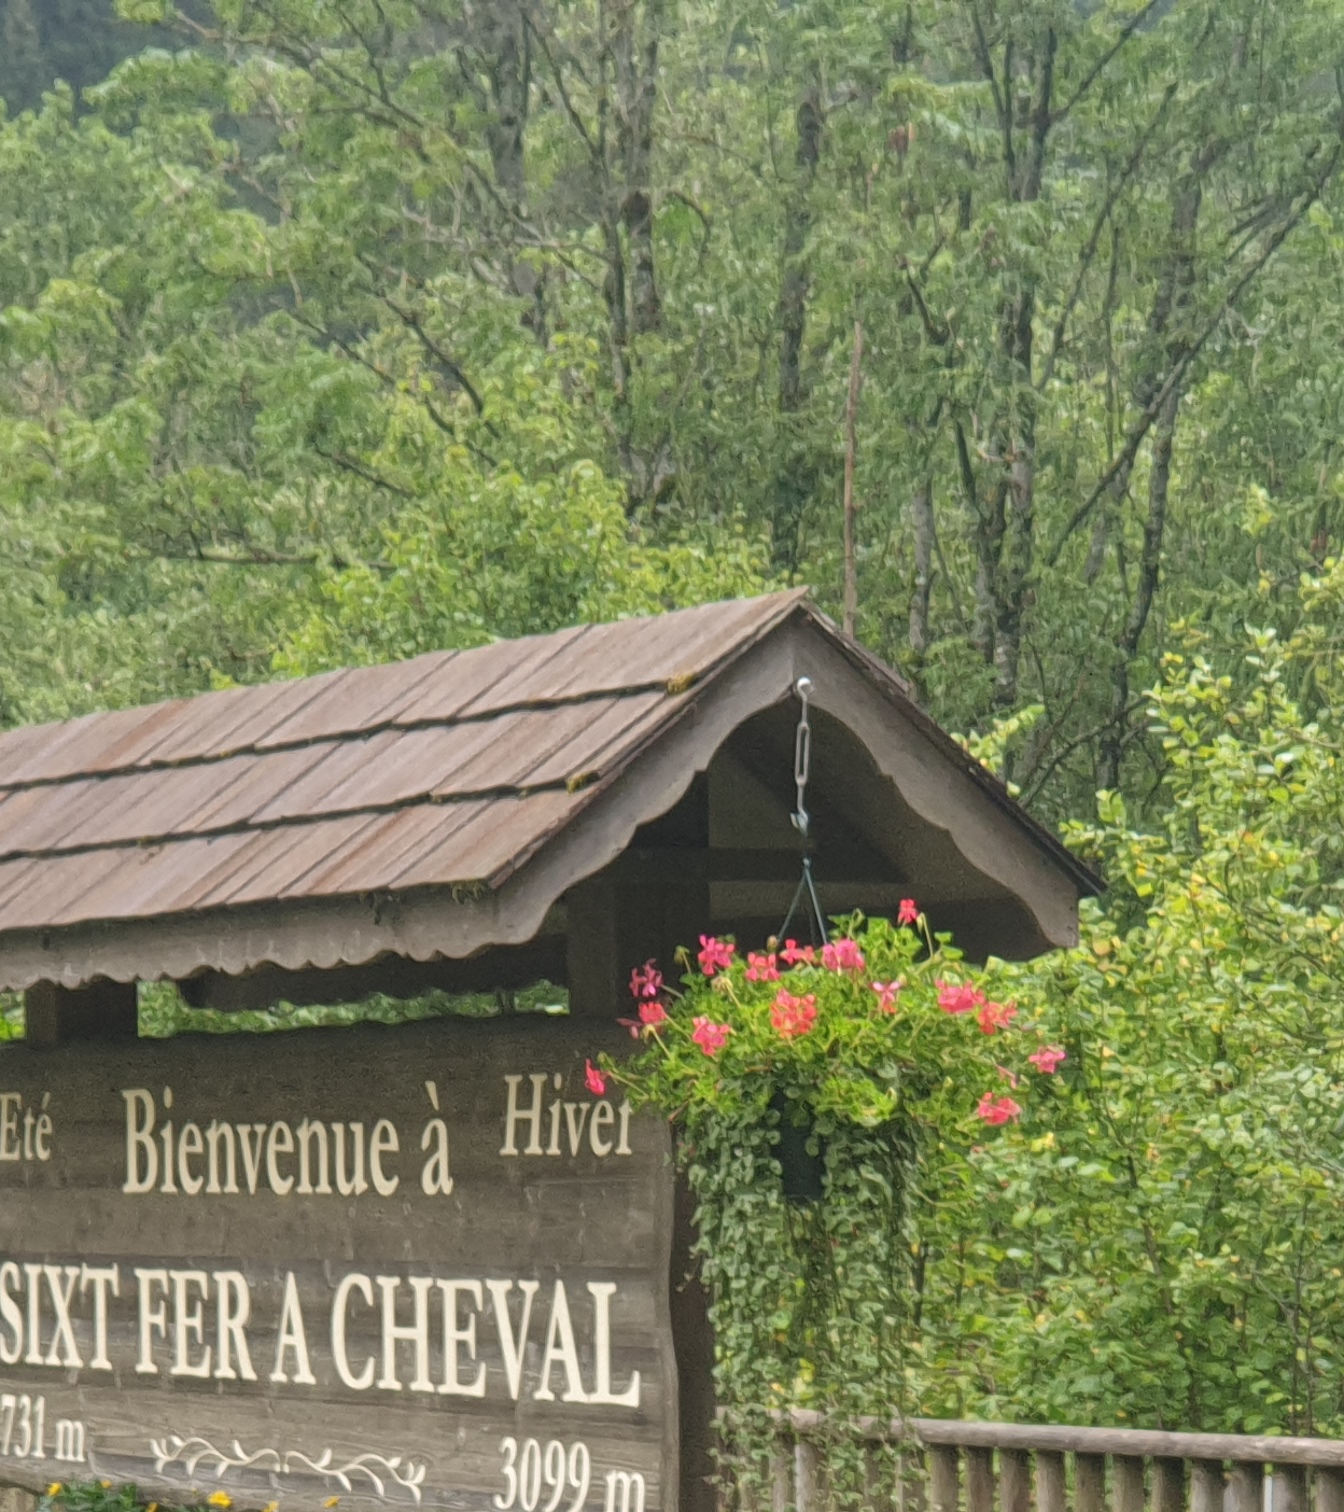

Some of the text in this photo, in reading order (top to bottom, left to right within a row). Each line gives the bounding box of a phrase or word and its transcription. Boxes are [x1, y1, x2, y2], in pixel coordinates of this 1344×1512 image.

[121, 1080, 454, 1196] Bienvenue à
[499, 1073, 634, 1157] Hiver
[135, 1267, 257, 1382] FER
[270, 1271, 317, 1385] A
[331, 1274, 641, 1408] CHEVAL
[1, 1395, 86, 1463] 731 m
